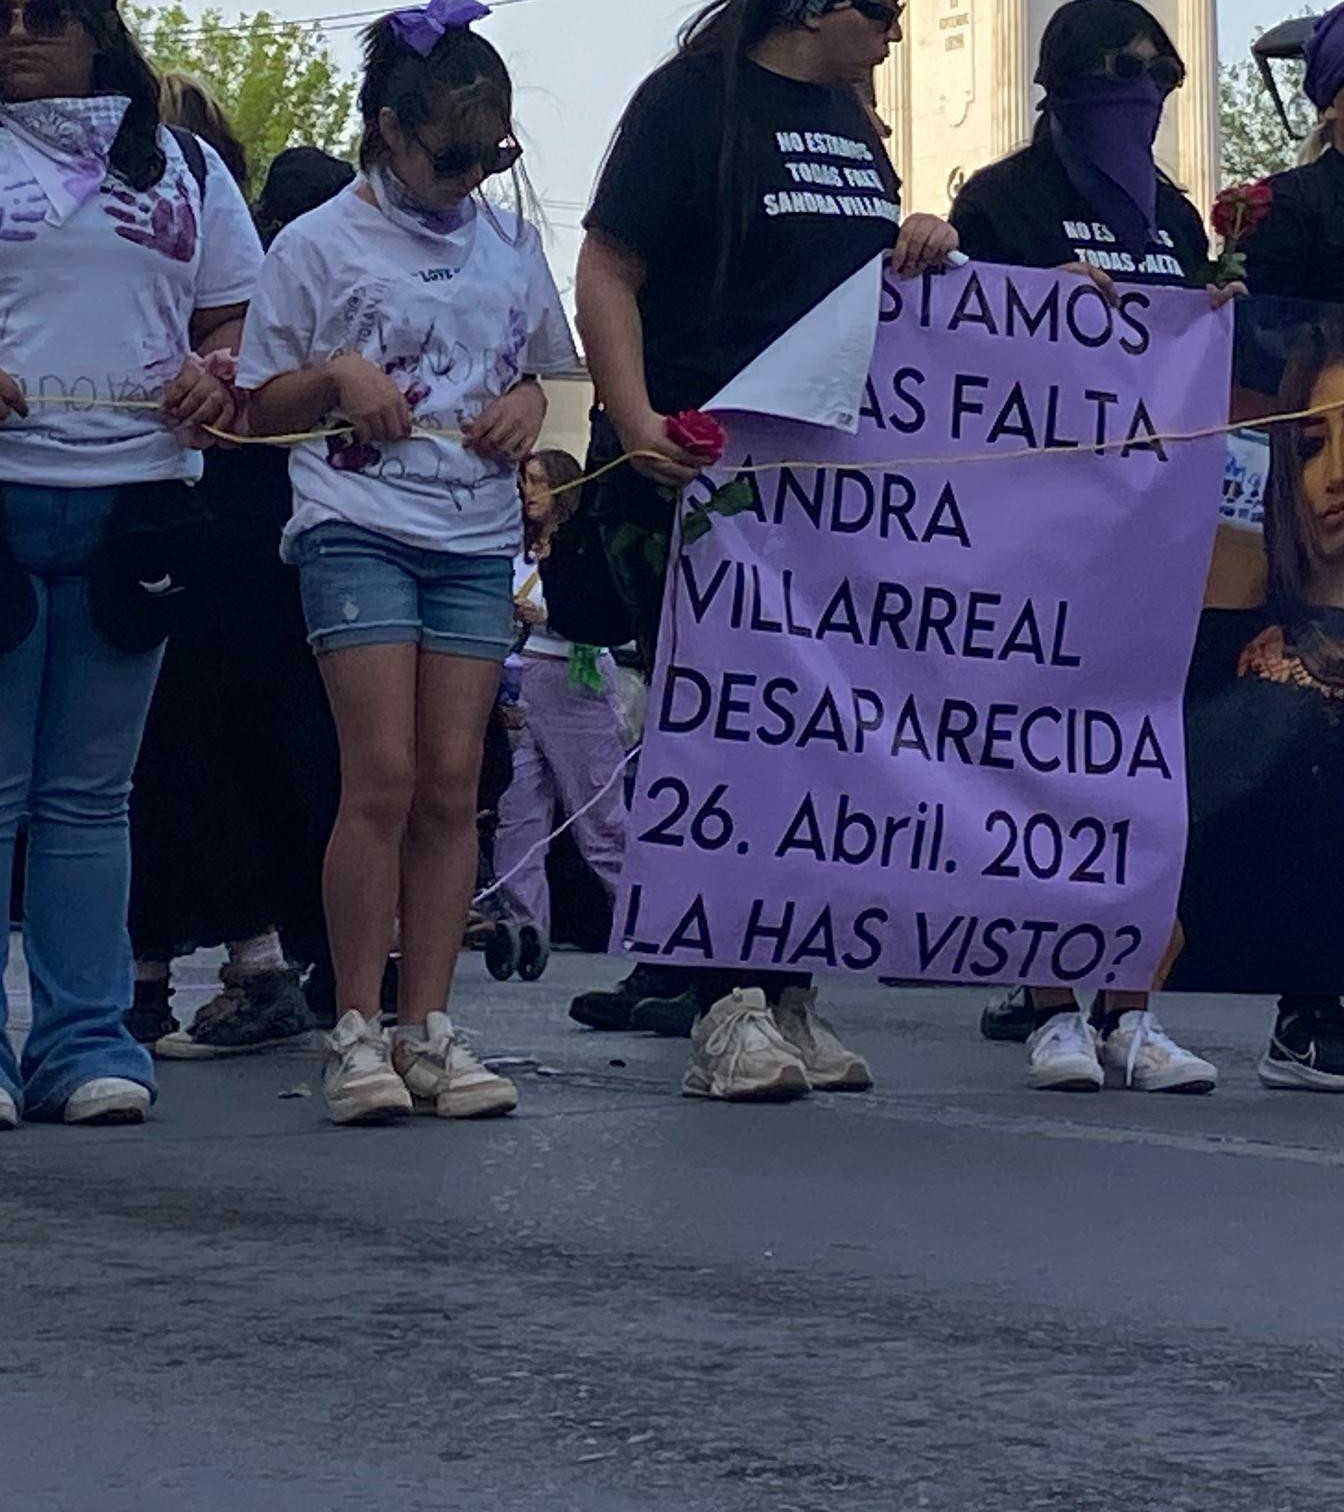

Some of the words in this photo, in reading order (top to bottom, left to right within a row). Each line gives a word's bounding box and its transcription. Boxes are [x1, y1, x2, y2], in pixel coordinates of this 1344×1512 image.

[775, 131, 805, 153] NO
[763, 191, 841, 216] SANDRA
[1062, 220, 1092, 241] NO
[880, 257, 1150, 355] STAMOS
[951, 373, 1168, 462] FALTA
[680, 554, 1082, 668] VILLARREAL
[657, 664, 1173, 781] DESAPARECIDA
[636, 776, 749, 856] 26.
[773, 791, 958, 875] Abril.
[981, 808, 1132, 887] 2021
[622, 884, 714, 960] LA
[739, 898, 889, 970] HAS
[914, 911, 1143, 984] VISTO?
